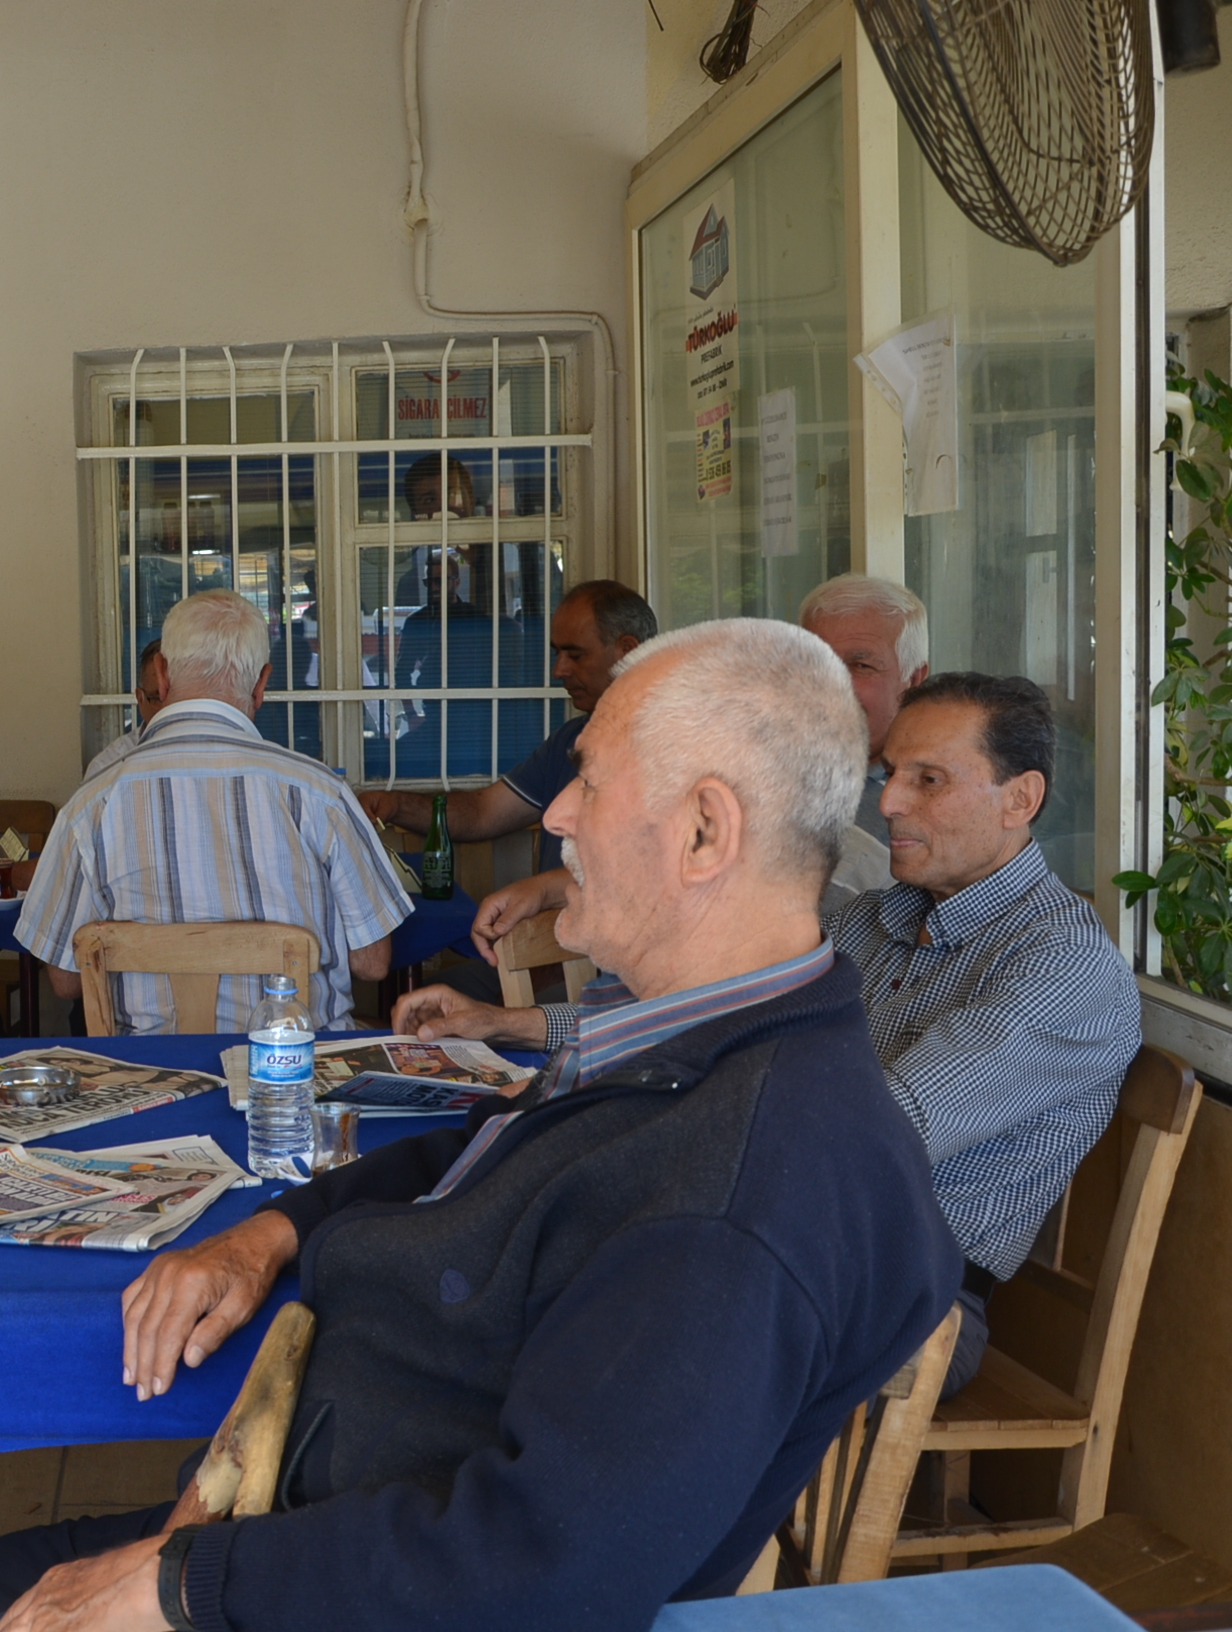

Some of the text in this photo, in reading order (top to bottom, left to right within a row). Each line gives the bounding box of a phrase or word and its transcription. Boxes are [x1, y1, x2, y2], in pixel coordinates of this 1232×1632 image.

[687, 308, 735, 353] TÜRKOĞLU
[398, 395, 487, 422] SİGARA ÇİLMEZ
[266, 1053, 302, 1065] ÖZSU
